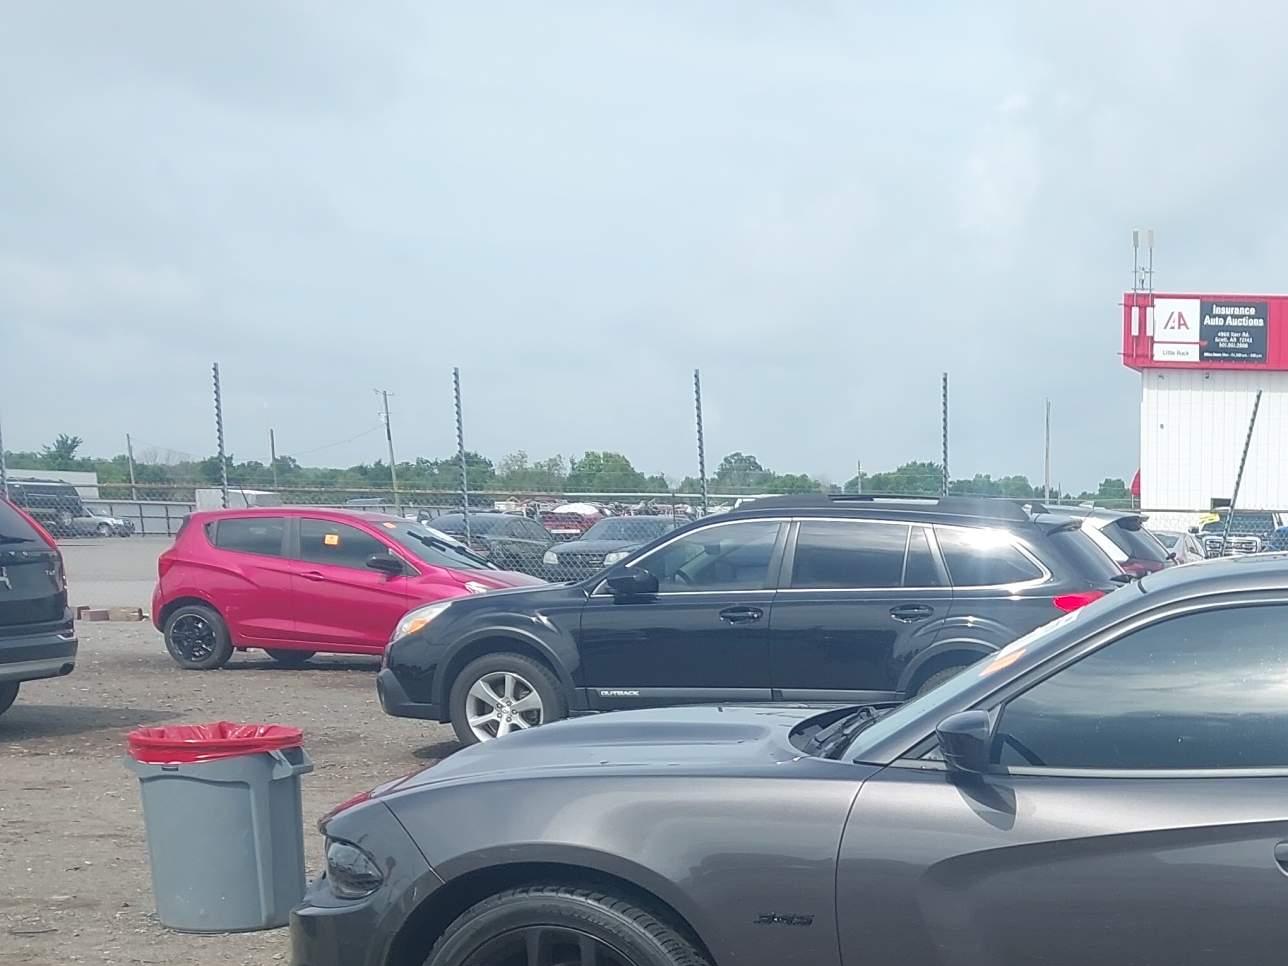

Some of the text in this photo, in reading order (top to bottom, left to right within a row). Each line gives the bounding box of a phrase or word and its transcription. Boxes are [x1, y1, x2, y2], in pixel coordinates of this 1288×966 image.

[1212, 304, 1256, 315] Insurance
[1203, 316, 1265, 327] Auto Auctions
